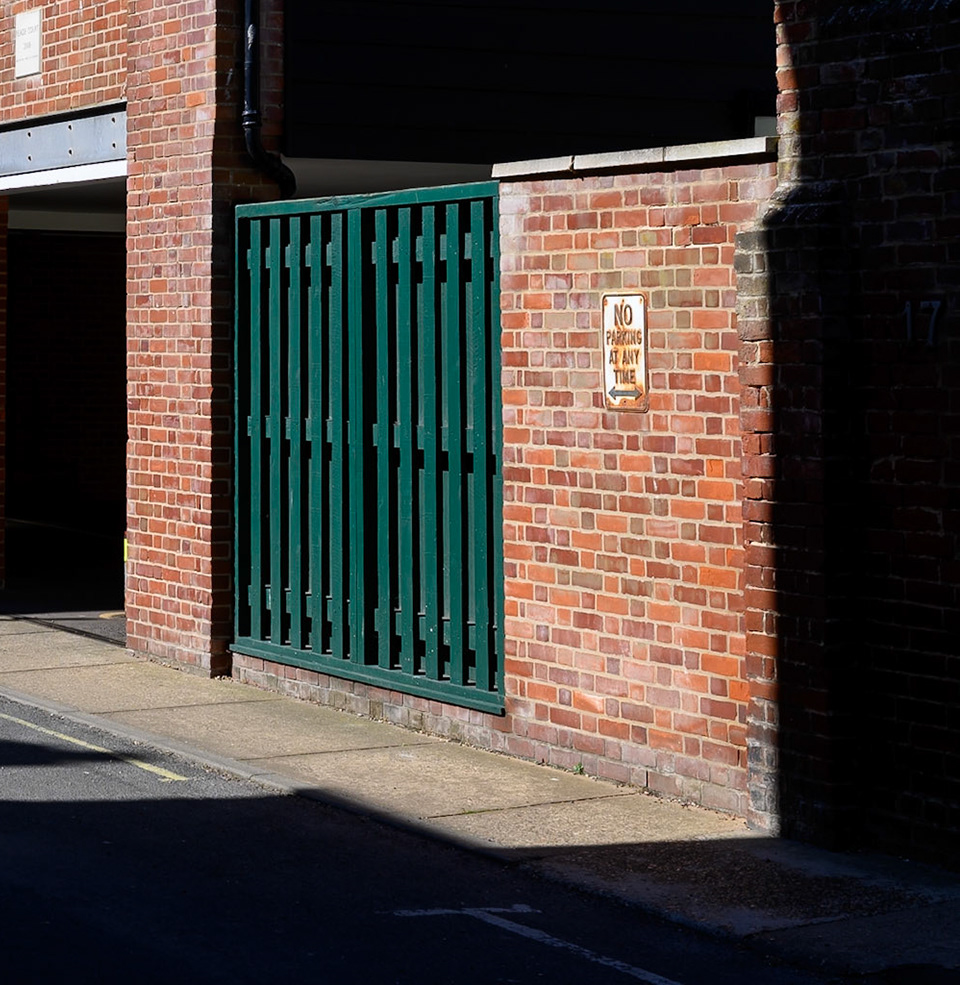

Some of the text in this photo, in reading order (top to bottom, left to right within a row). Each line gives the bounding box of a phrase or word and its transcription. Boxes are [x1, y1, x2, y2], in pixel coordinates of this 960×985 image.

[614, 304, 633, 326] NO
[901, 300, 942, 346] 17
[606, 330, 642, 346] PARKING
[609, 350, 640, 364] AT ANY
[613, 369, 636, 384] TIME
